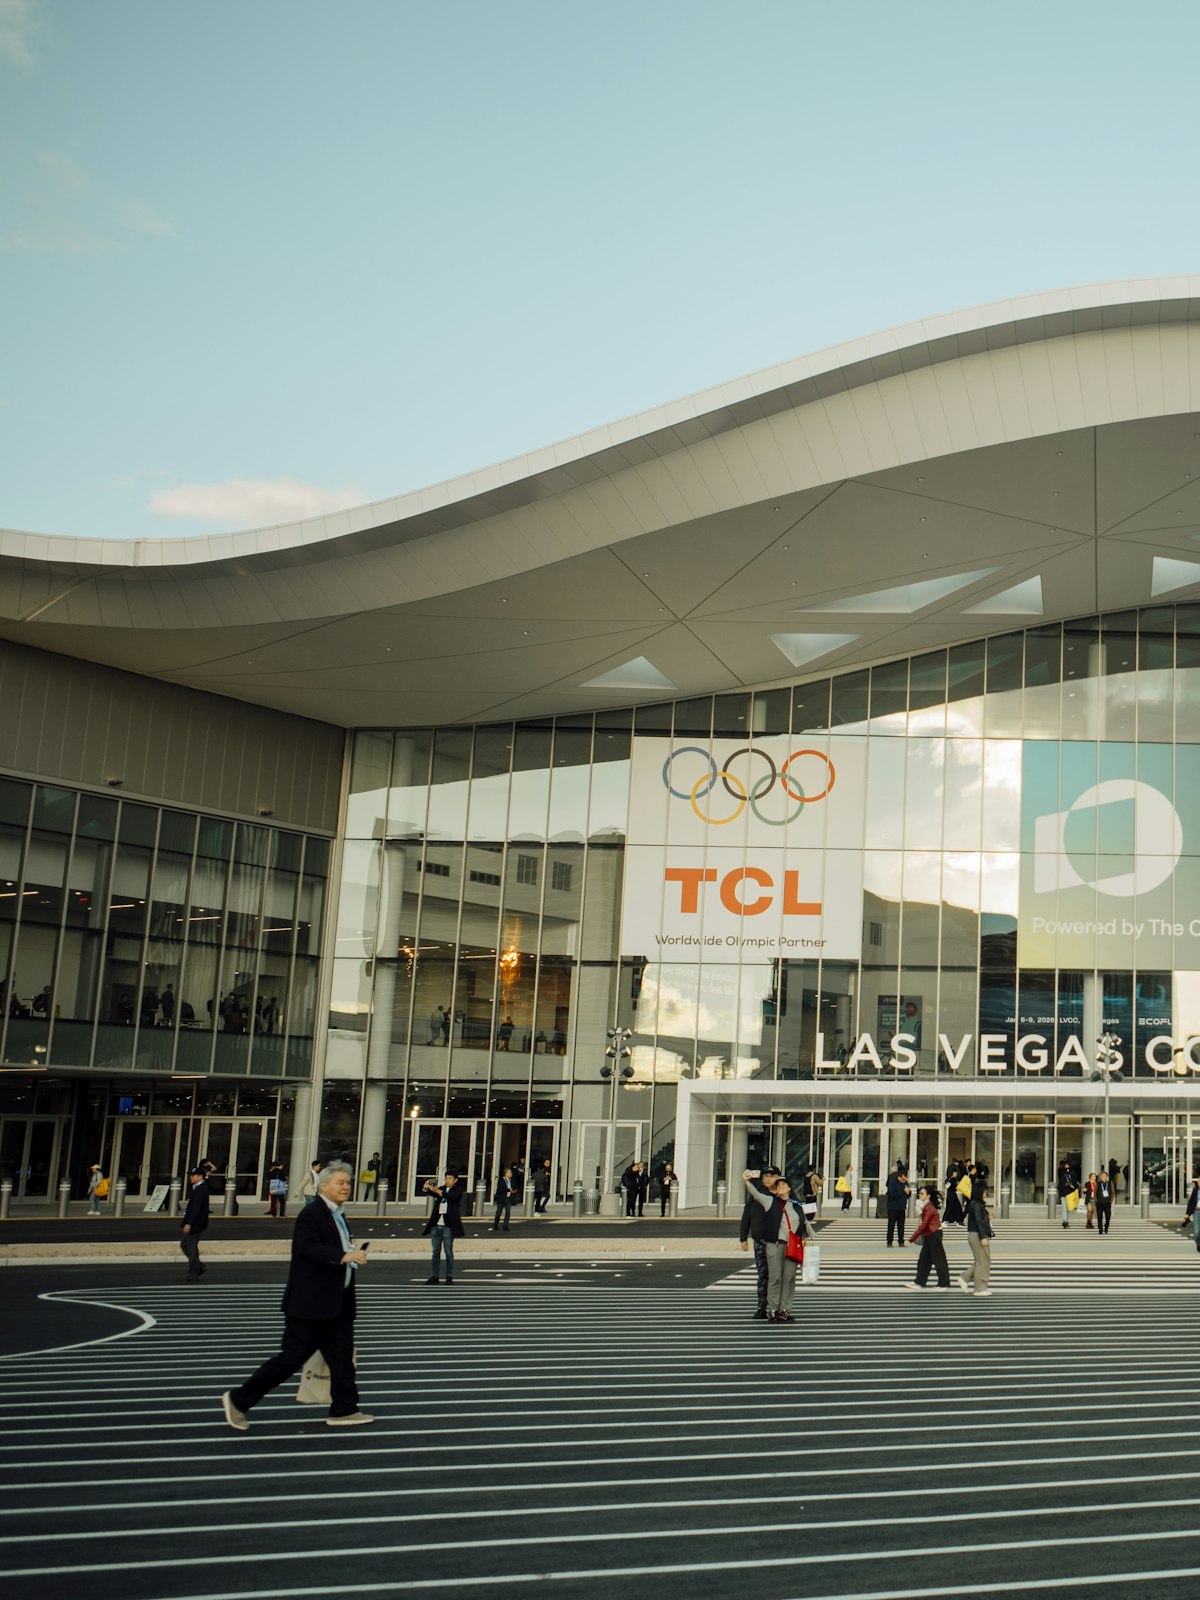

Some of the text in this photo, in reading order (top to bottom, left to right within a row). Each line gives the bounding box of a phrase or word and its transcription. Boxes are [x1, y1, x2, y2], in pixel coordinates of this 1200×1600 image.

[665, 867, 822, 916] TCL
[1032, 917, 1116, 935] Powered
[1122, 918, 1144, 939] by
[1148, 919, 1184, 936] The
[655, 934, 827, 949] Worldwide Olympic Partner
[1020, 1016, 1035, 1024] 6-9,
[1037, 1016, 1055, 1024] 2026
[1059, 1017, 1081, 1025] LVCC,
[1101, 1018, 1120, 1026] egas
[1138, 1018, 1178, 1026] ECOFL
[815, 1032, 917, 1070] LAS
[939, 1033, 1124, 1072] VEGAS
